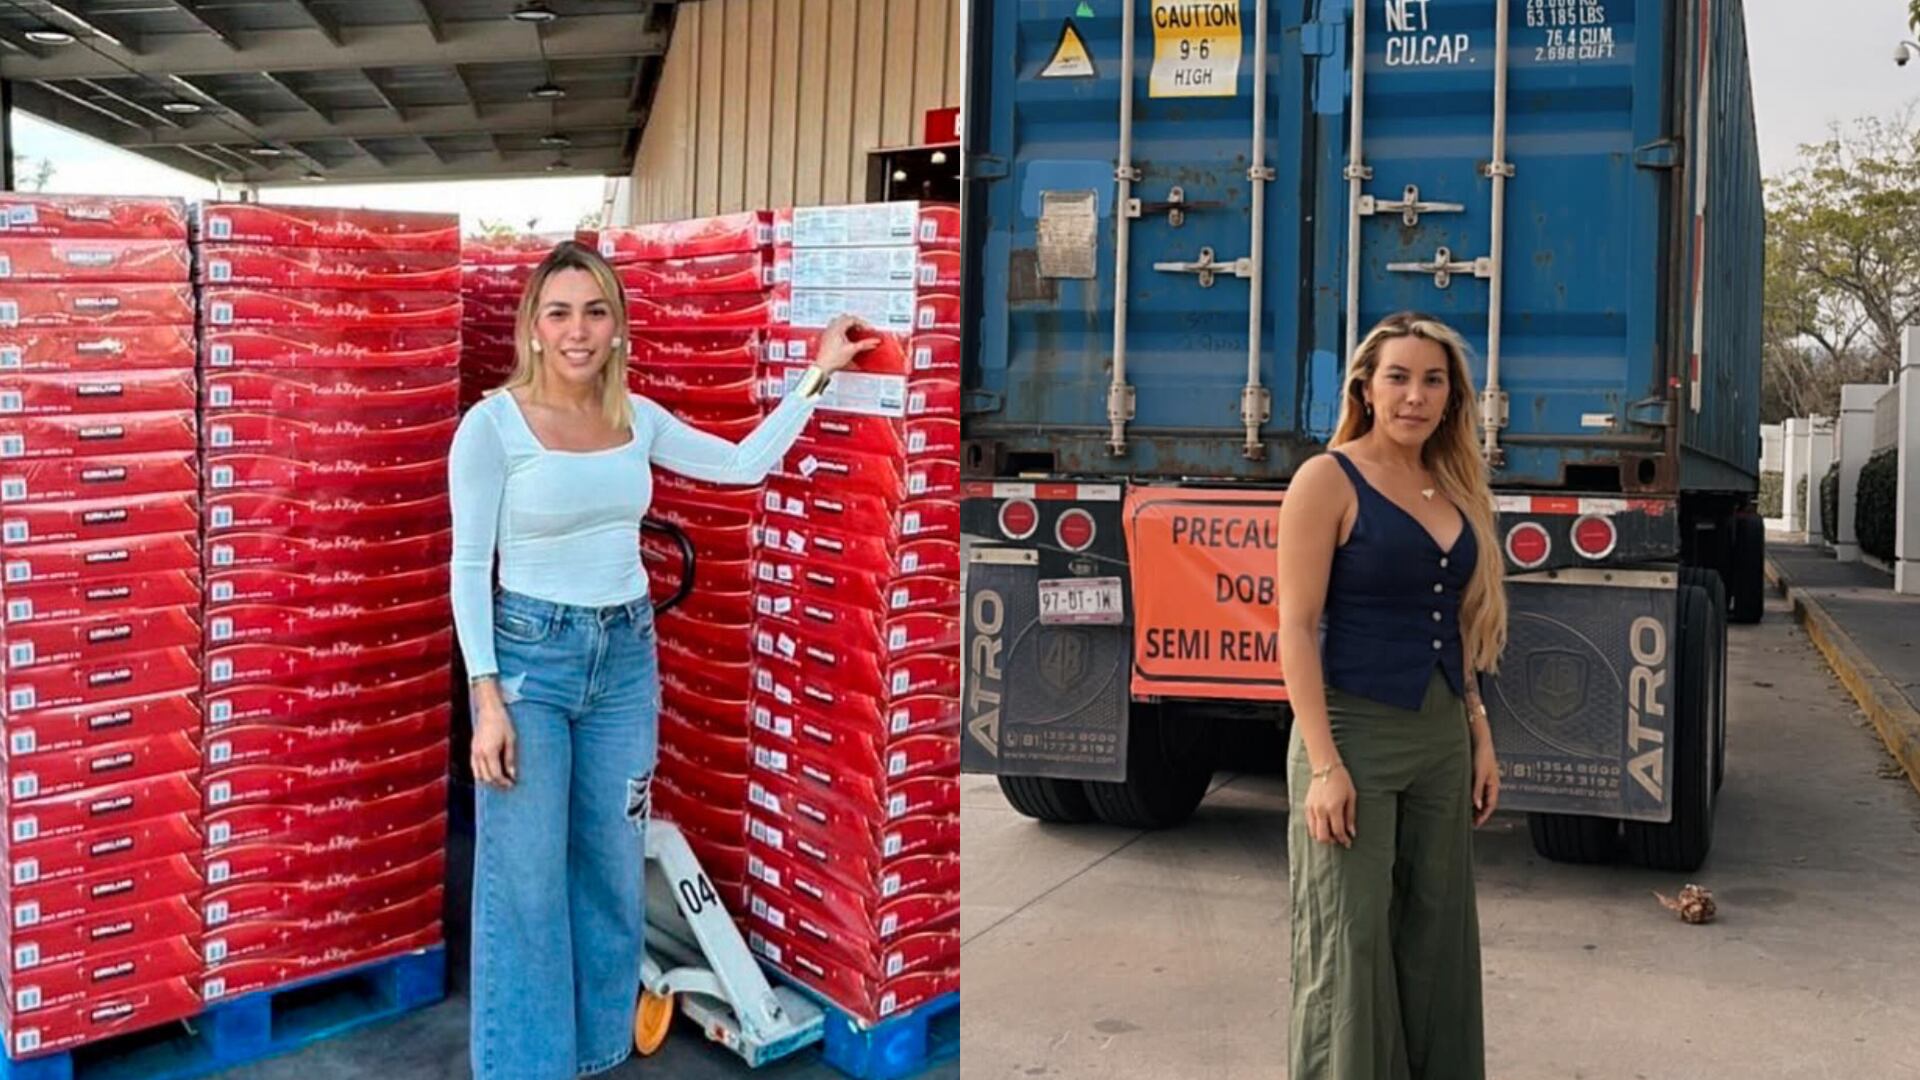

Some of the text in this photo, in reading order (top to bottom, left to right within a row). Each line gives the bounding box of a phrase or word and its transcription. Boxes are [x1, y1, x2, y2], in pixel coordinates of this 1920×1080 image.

[1155, 4, 1238, 29] CAUTION
[1385, 0, 1430, 32] NET
[1526, 6, 1605, 27] 63.185 LBS
[1385, 33, 1476, 66] CU.CAP.
[1535, 46, 1576, 61] 2.698
[1546, 28, 1576, 47] 76.4
[1174, 68, 1213, 86] HIGH
[1146, 627, 1278, 663] SEMI REM
[968, 589, 1005, 760] ATRO
[1627, 615, 1667, 803] ATRO
[679, 874, 717, 914] 04
